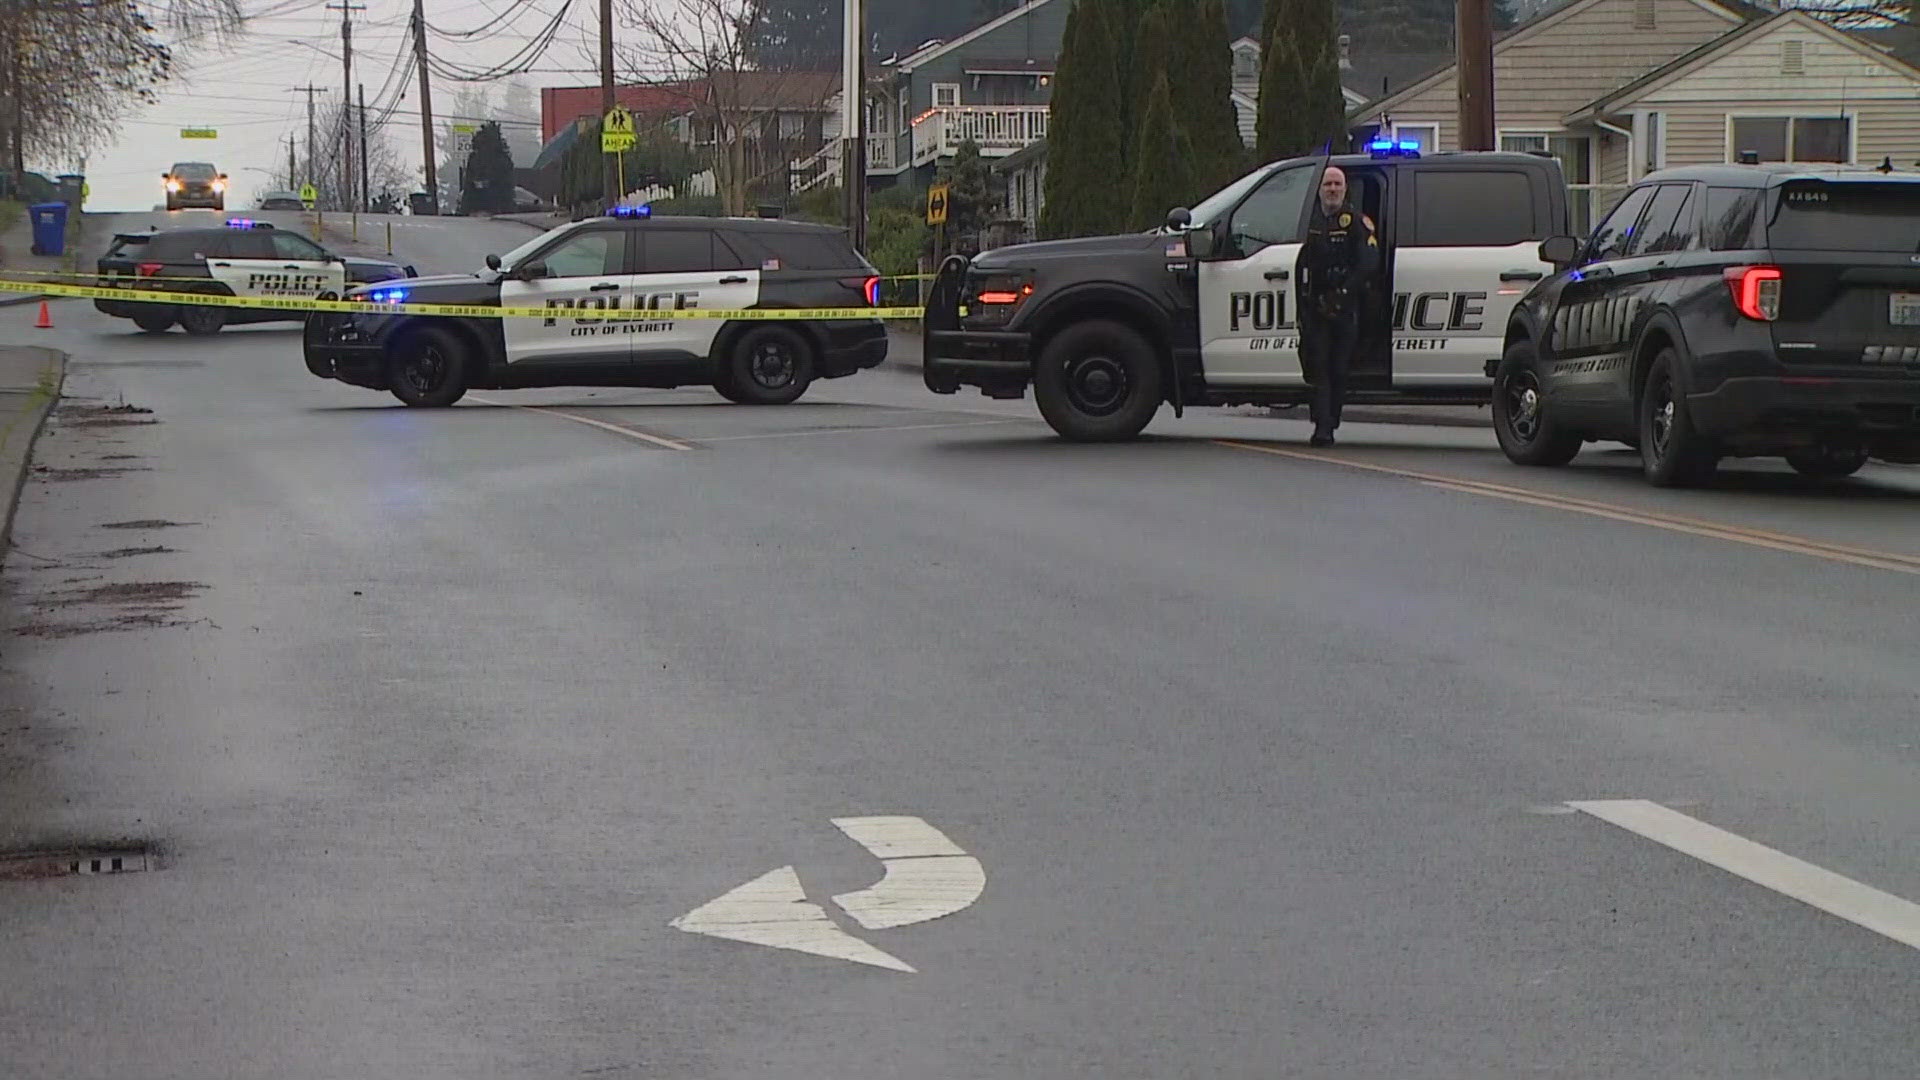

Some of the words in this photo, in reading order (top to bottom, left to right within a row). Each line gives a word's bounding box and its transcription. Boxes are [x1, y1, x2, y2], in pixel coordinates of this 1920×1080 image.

[248, 273, 329, 291] POLICE
[544, 291, 700, 328] POLICE
[570, 327, 598, 337] CITY
[602, 325, 616, 335] OF
[622, 322, 675, 334] EVERETT
[1249, 338, 1270, 350] CITY
[1273, 338, 1286, 349] OF
